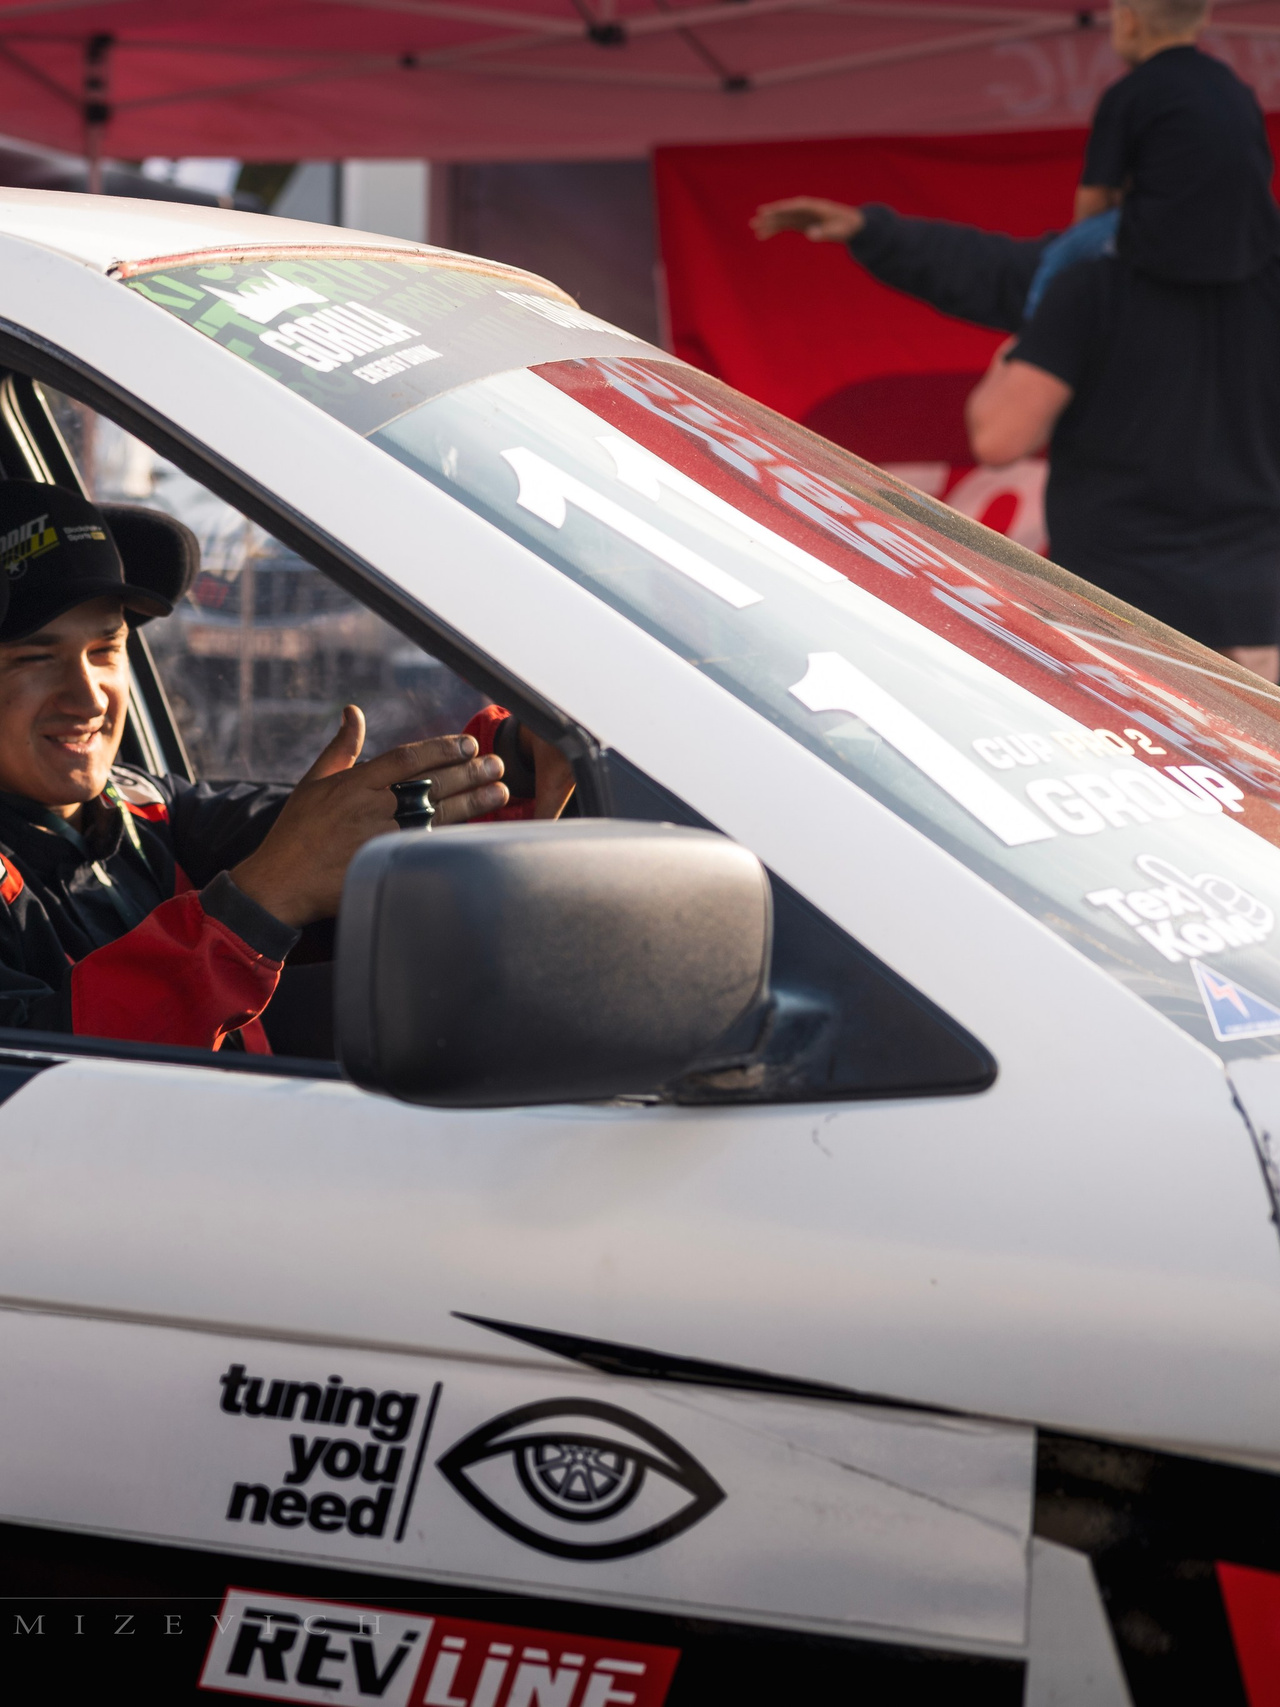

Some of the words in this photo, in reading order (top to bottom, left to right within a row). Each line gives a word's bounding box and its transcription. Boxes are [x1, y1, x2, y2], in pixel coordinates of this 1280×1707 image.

[258, 300, 422, 373] GORILLA
[352, 354, 412, 385] ENERGY
[395, 343, 444, 366] DRINK
[971, 732, 1053, 770] CUP
[1050, 728, 1135, 758] PRO
[1123, 728, 1167, 755] 2
[1025, 764, 1245, 836] GROUP
[220, 1364, 419, 1442] tuning
[284, 1434, 407, 1485] you
[226, 1481, 395, 1538] need
